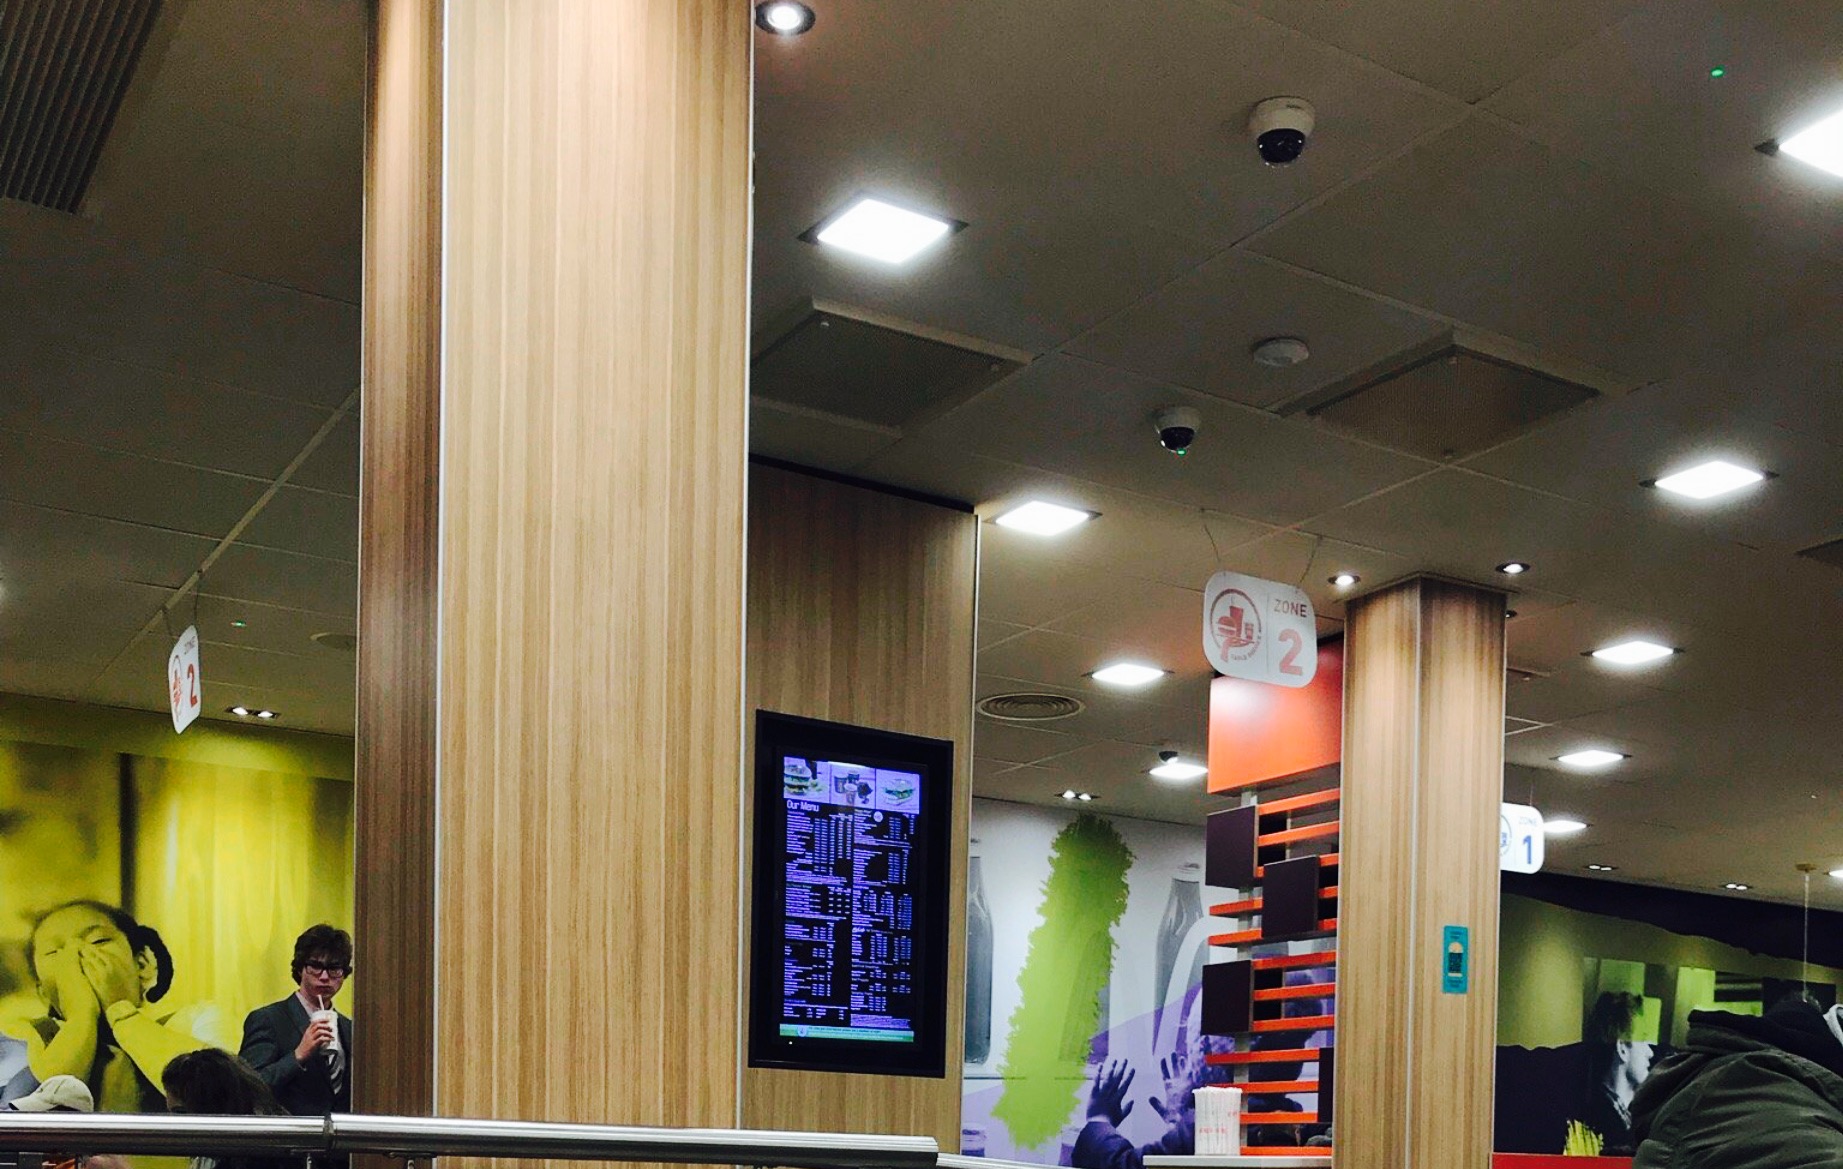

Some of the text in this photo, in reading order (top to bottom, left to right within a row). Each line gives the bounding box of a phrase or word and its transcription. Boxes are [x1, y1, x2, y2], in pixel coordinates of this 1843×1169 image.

[1274, 599, 1307, 618] ZONE
[1278, 628, 1303, 676] 2
[187, 663, 198, 708] 2
[786, 799, 819, 812] Our Menu
[1522, 834, 1532, 865] 1
